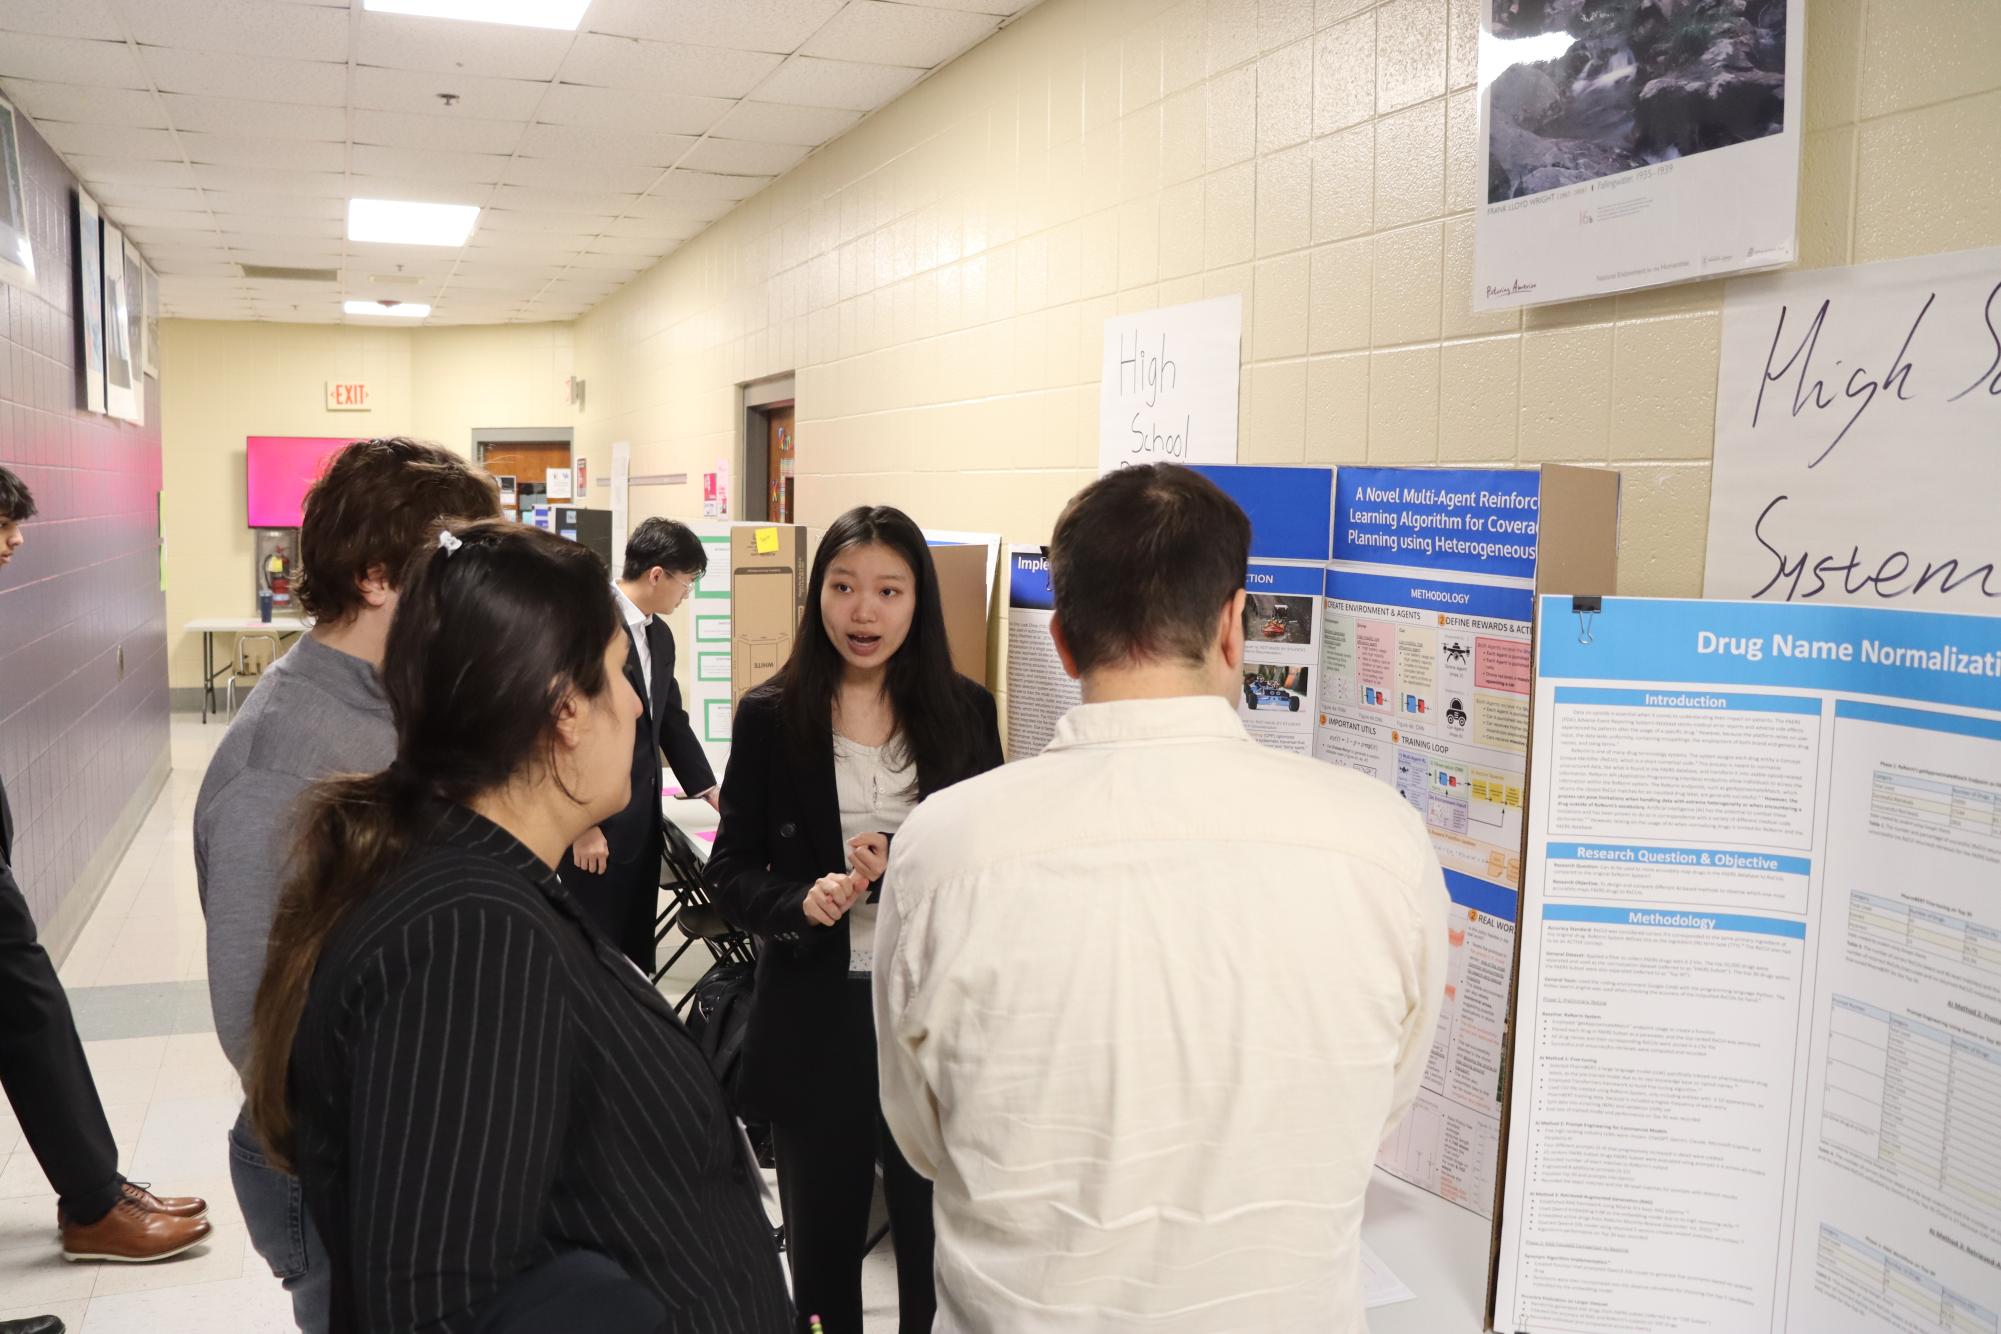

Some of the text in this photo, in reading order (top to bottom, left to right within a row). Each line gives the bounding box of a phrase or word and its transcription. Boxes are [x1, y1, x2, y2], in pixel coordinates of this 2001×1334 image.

[1530, 193, 1555, 206] WRIGHT
[1120, 328, 1176, 408] High
[1753, 292, 1936, 469] High
[336, 384, 365, 405] EXIT
[1131, 412, 1190, 459] School
[1355, 486, 1540, 510] A Novel Multi-Agent Reinforc
[1350, 508, 1397, 530] Learning
[1400, 511, 1462, 530] Algorithm
[1466, 514, 1484, 531] for
[1348, 530, 1536, 560] Planning using Heterogeneous
[1246, 574, 1274, 584] TION
[1410, 588, 1470, 605] METHODOLOGY
[1345, 603, 1390, 617] ENVIRONMENT
[1391, 608, 1396, 617] &
[1397, 608, 1421, 620] AGENTS
[1446, 616, 1470, 628] DEFINE
[1472, 619, 1508, 633] REWARDS
[1508, 624, 1515, 632] &
[1698, 632, 2001, 678] Drug Name Normalizati
[1645, 694, 1727, 708] Introduction
[1328, 718, 1360, 732] IMPORTANT
[1361, 724, 1376, 736] UTILS
[1401, 736, 1431, 751] TRAINING
[1432, 742, 1449, 755] LOOP
[1576, 847, 1778, 870] Research Question & Objective
[1478, 915, 1495, 928] REAL
[1628, 912, 1716, 930] Methodology
